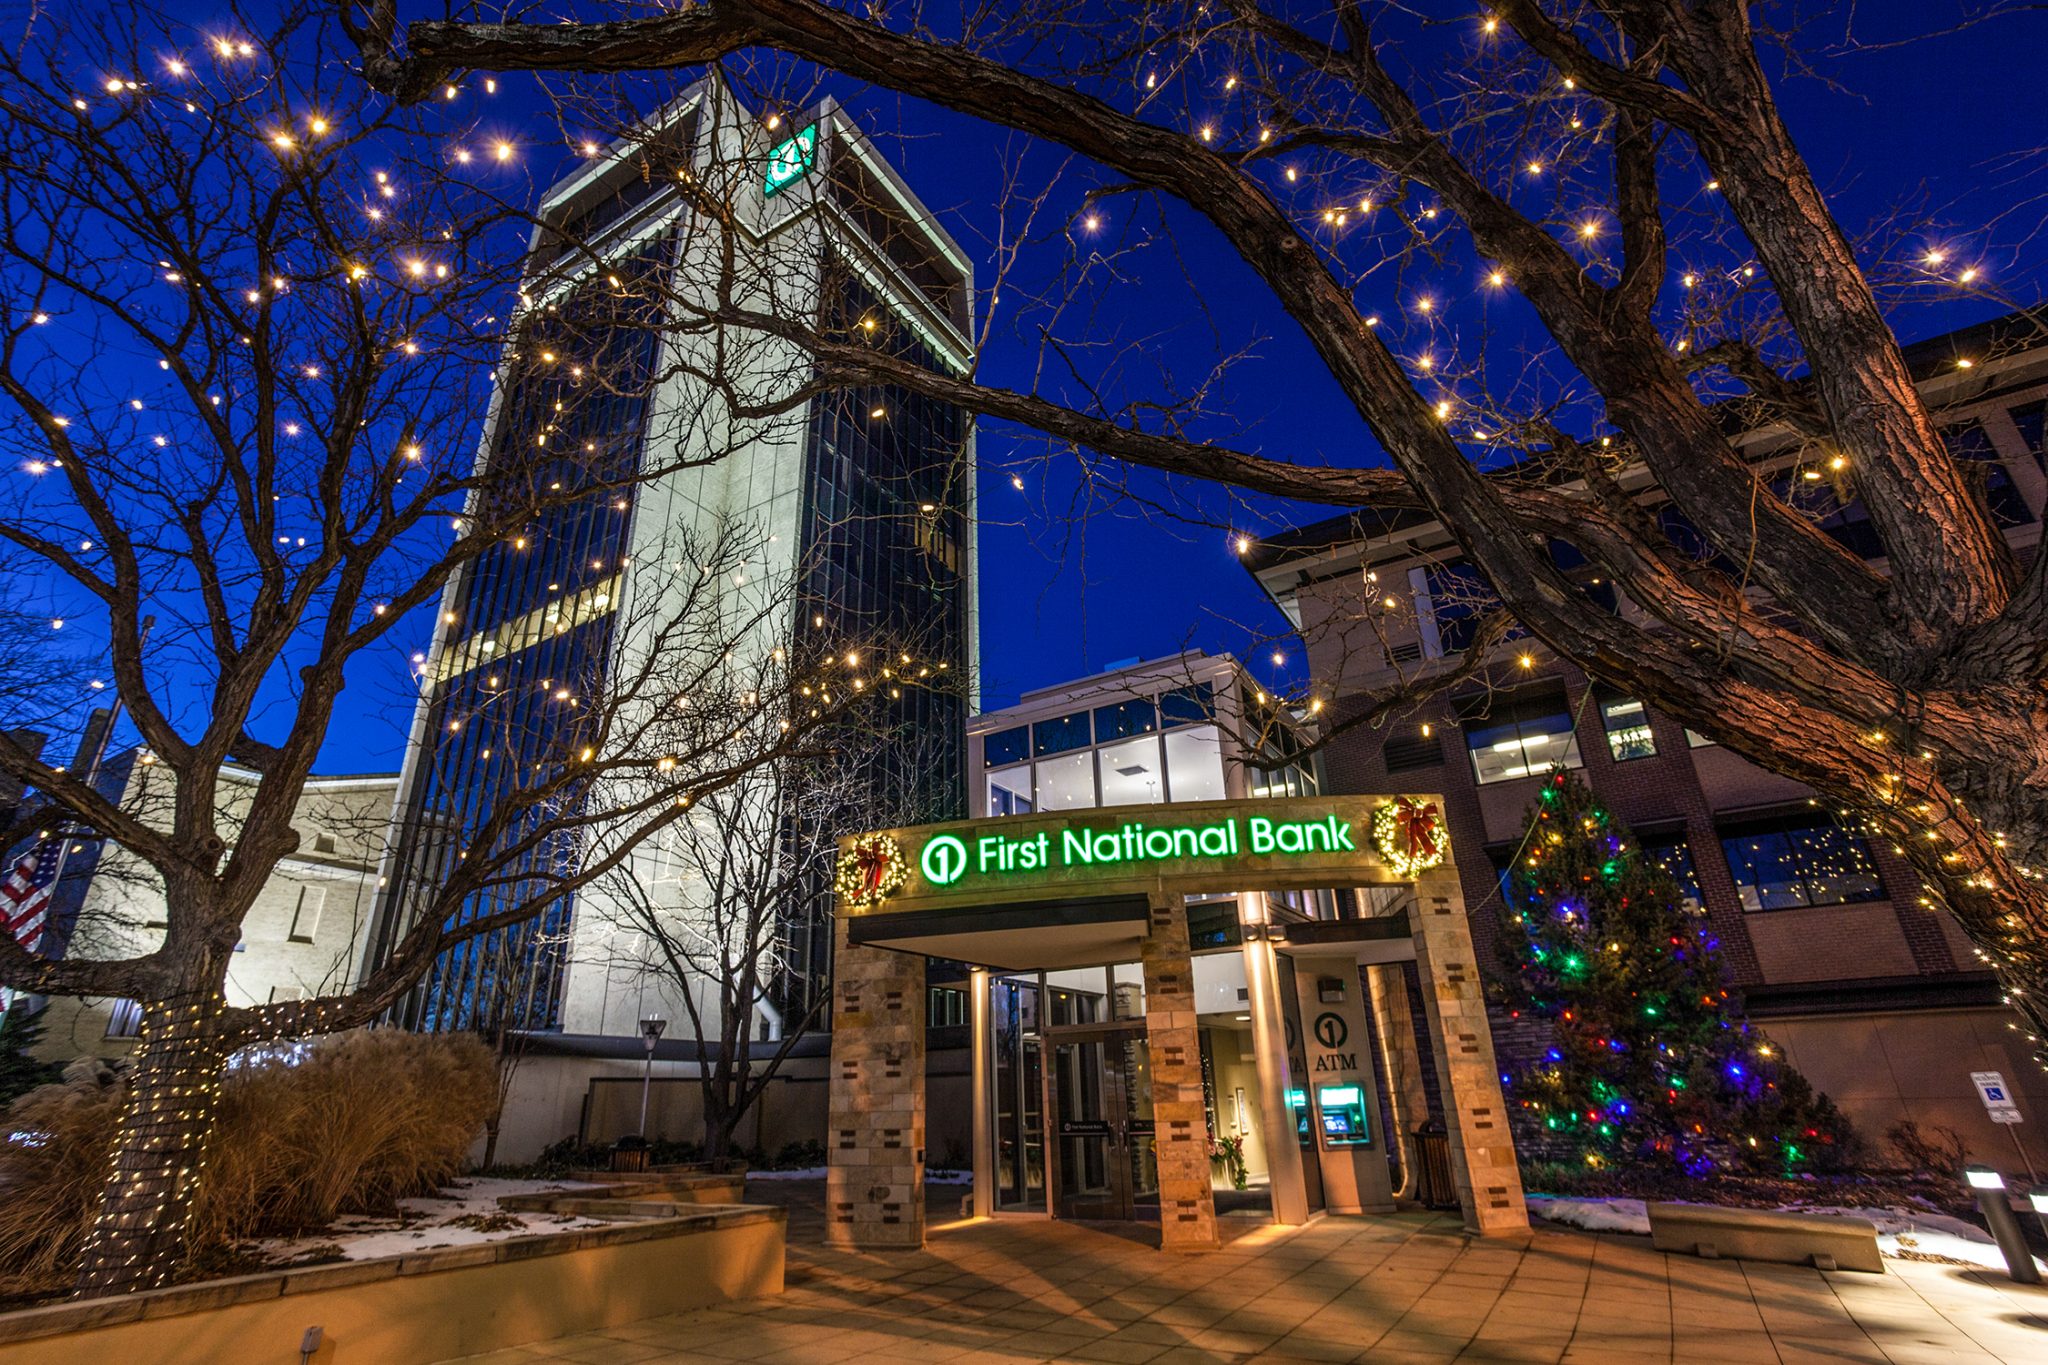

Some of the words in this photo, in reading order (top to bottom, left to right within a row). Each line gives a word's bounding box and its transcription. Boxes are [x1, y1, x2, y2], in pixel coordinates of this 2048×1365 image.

[979, 832, 1050, 873] First
[1063, 818, 1238, 864] National
[1249, 815, 1355, 853] Bank
[1315, 1053, 1358, 1072] ATM
